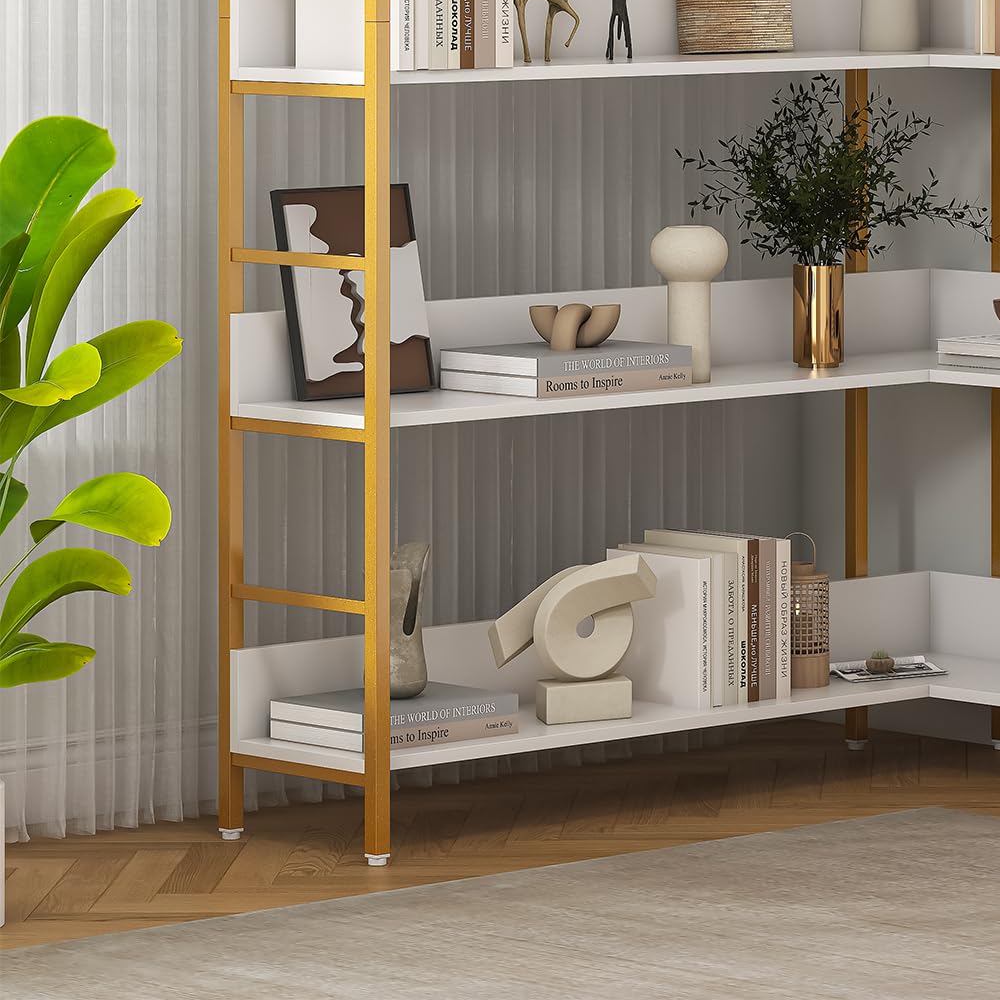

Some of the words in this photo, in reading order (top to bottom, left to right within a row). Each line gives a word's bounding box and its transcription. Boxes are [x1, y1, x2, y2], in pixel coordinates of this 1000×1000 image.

[464, 15, 473, 52] ЛУЧШЕ
[563, 361, 580, 372] THE
[581, 358, 612, 371] WORLD
[613, 357, 625, 368] OF
[626, 353, 670, 367] INTERIORS
[546, 379, 578, 393] Rooms
[580, 378, 590, 389] to
[592, 374, 623, 390] Inspire
[407, 711, 438, 724] WORLD
[439, 709, 451, 720] OF
[452, 702, 497, 717] INTERIORS
[406, 730, 415, 742] to
[418, 727, 449, 743] Inspire
